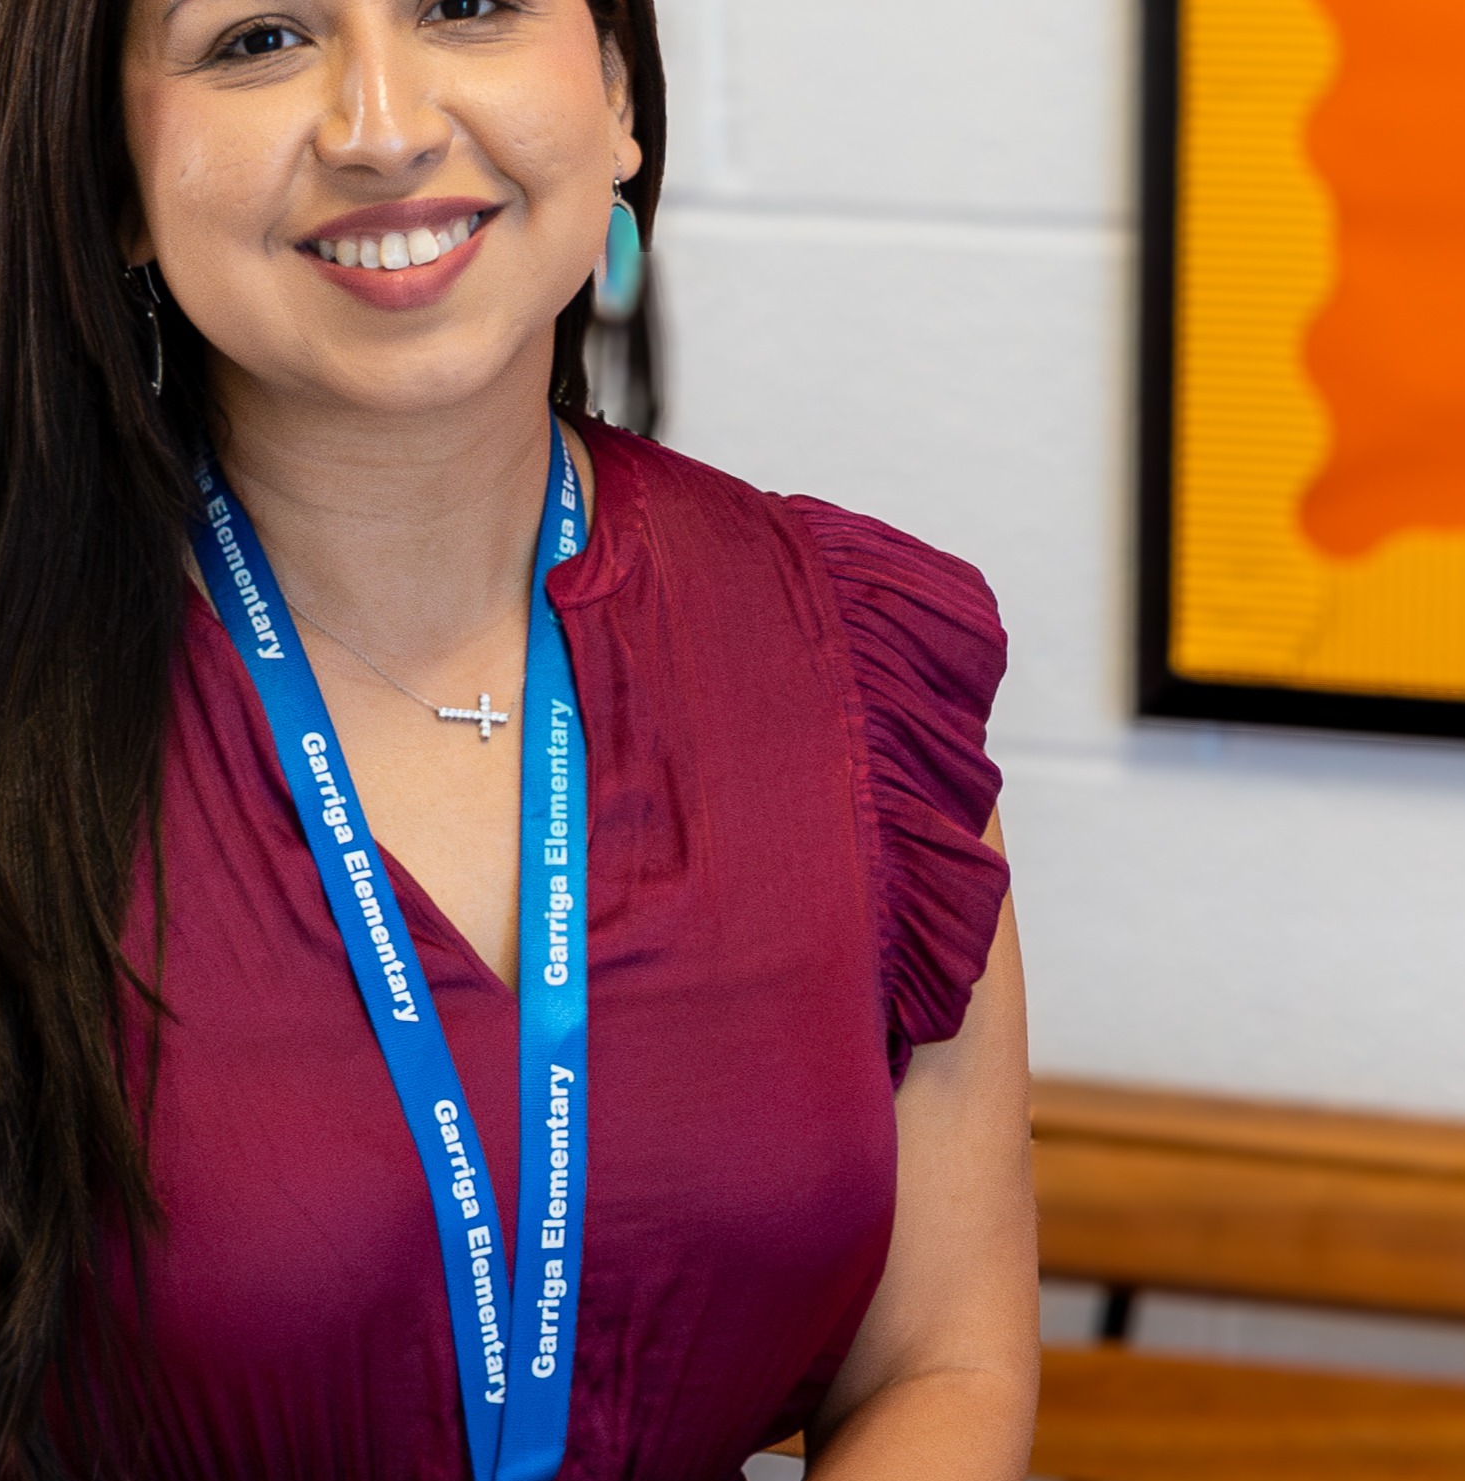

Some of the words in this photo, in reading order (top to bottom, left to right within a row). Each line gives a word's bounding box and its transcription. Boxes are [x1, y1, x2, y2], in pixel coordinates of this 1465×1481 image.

[207, 496, 285, 659] Elementary
[544, 699, 573, 866] Elementary
[301, 731, 354, 845] Garriga
[343, 850, 420, 1023] Elementary
[544, 875, 574, 987] Garriga
[541, 1063, 575, 1249] Elementary
[434, 1099, 480, 1219] Garriga
[467, 1225, 506, 1404] Elementary
[531, 1259, 567, 1379] Garriga
